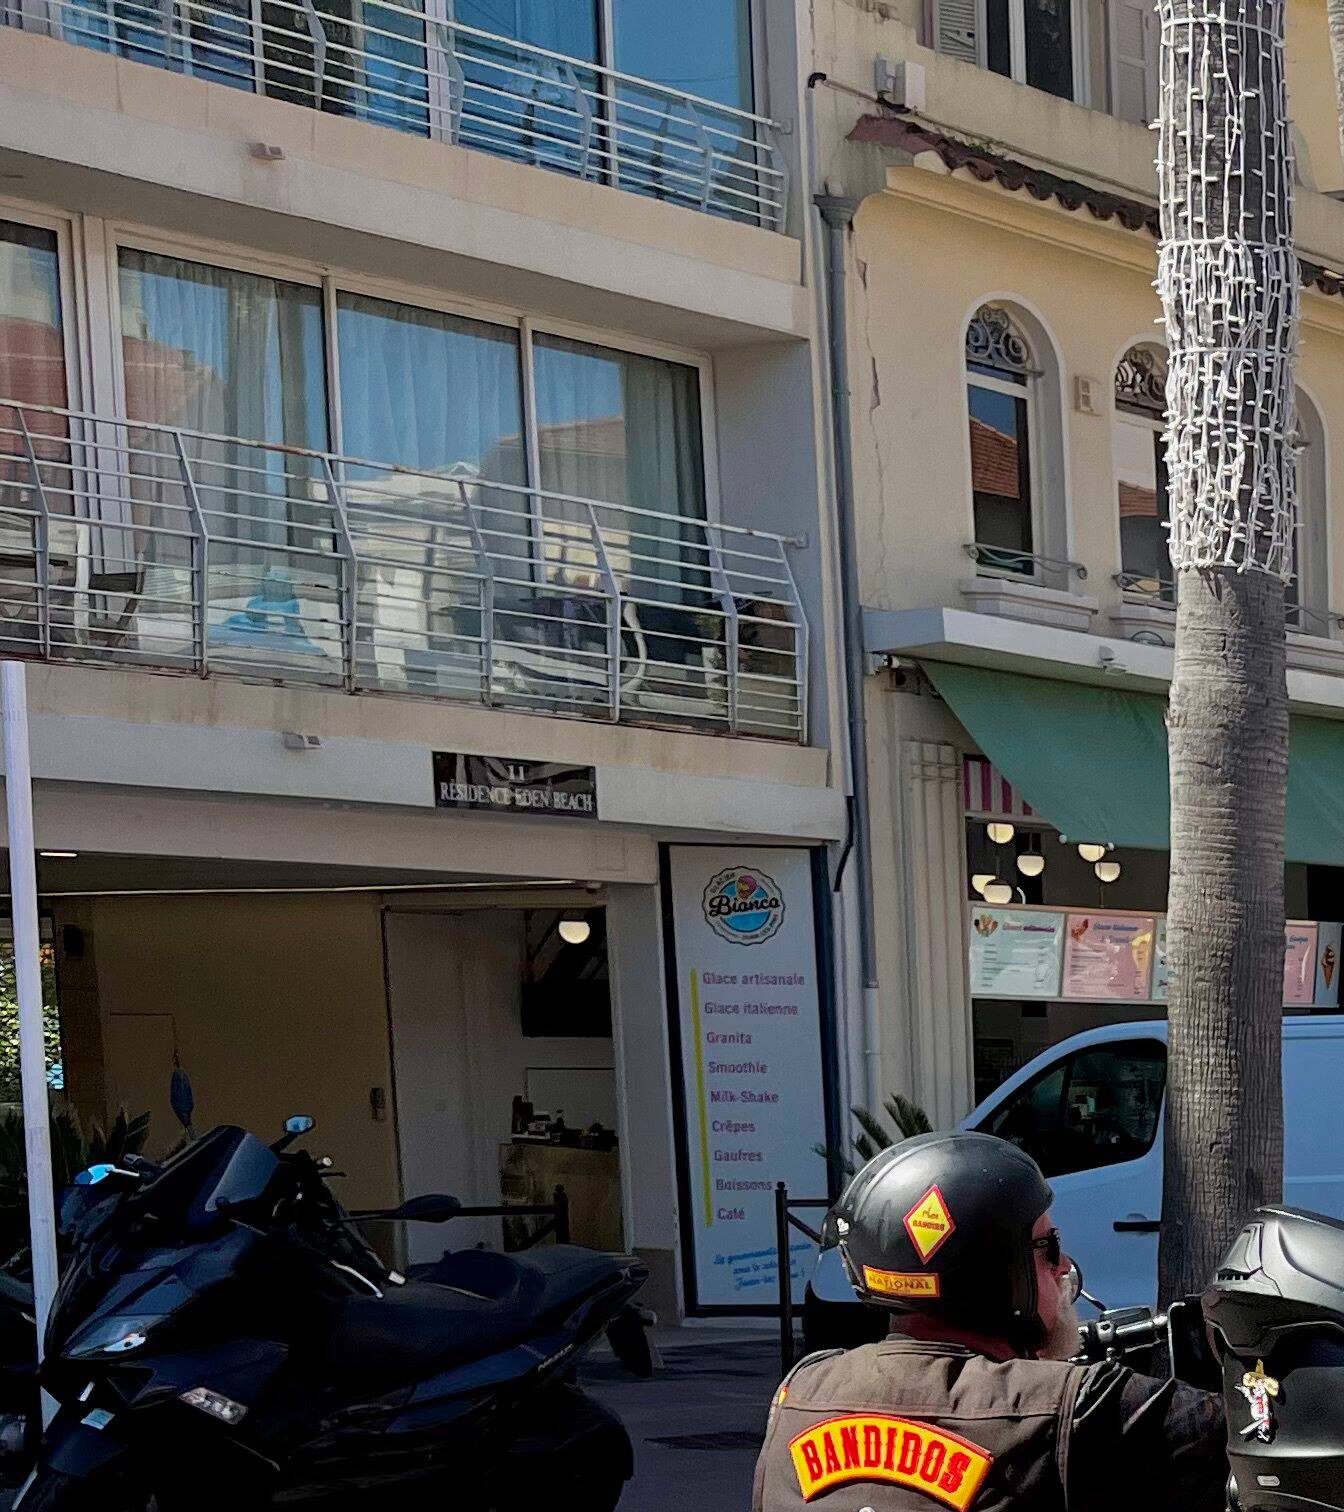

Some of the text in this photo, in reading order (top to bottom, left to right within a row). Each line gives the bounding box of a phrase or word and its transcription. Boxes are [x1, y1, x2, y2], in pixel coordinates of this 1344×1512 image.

[508, 764, 526, 782] 11
[514, 787, 551, 808] EDEN
[552, 791, 593, 812] BEACH
[702, 972, 805, 986] Glace artisanale
[704, 1002, 798, 1016] Glace italienne
[706, 1031, 753, 1045] Granita
[708, 1061, 768, 1075] Smoothie
[711, 1119, 756, 1134] Crêpes
[714, 1148, 763, 1162] Gaufres
[716, 1178, 773, 1191] Boissons
[718, 1207, 745, 1220] Café
[868, 1275, 933, 1291] NATIONAL
[801, 1424, 972, 1494] BANDIDOS
